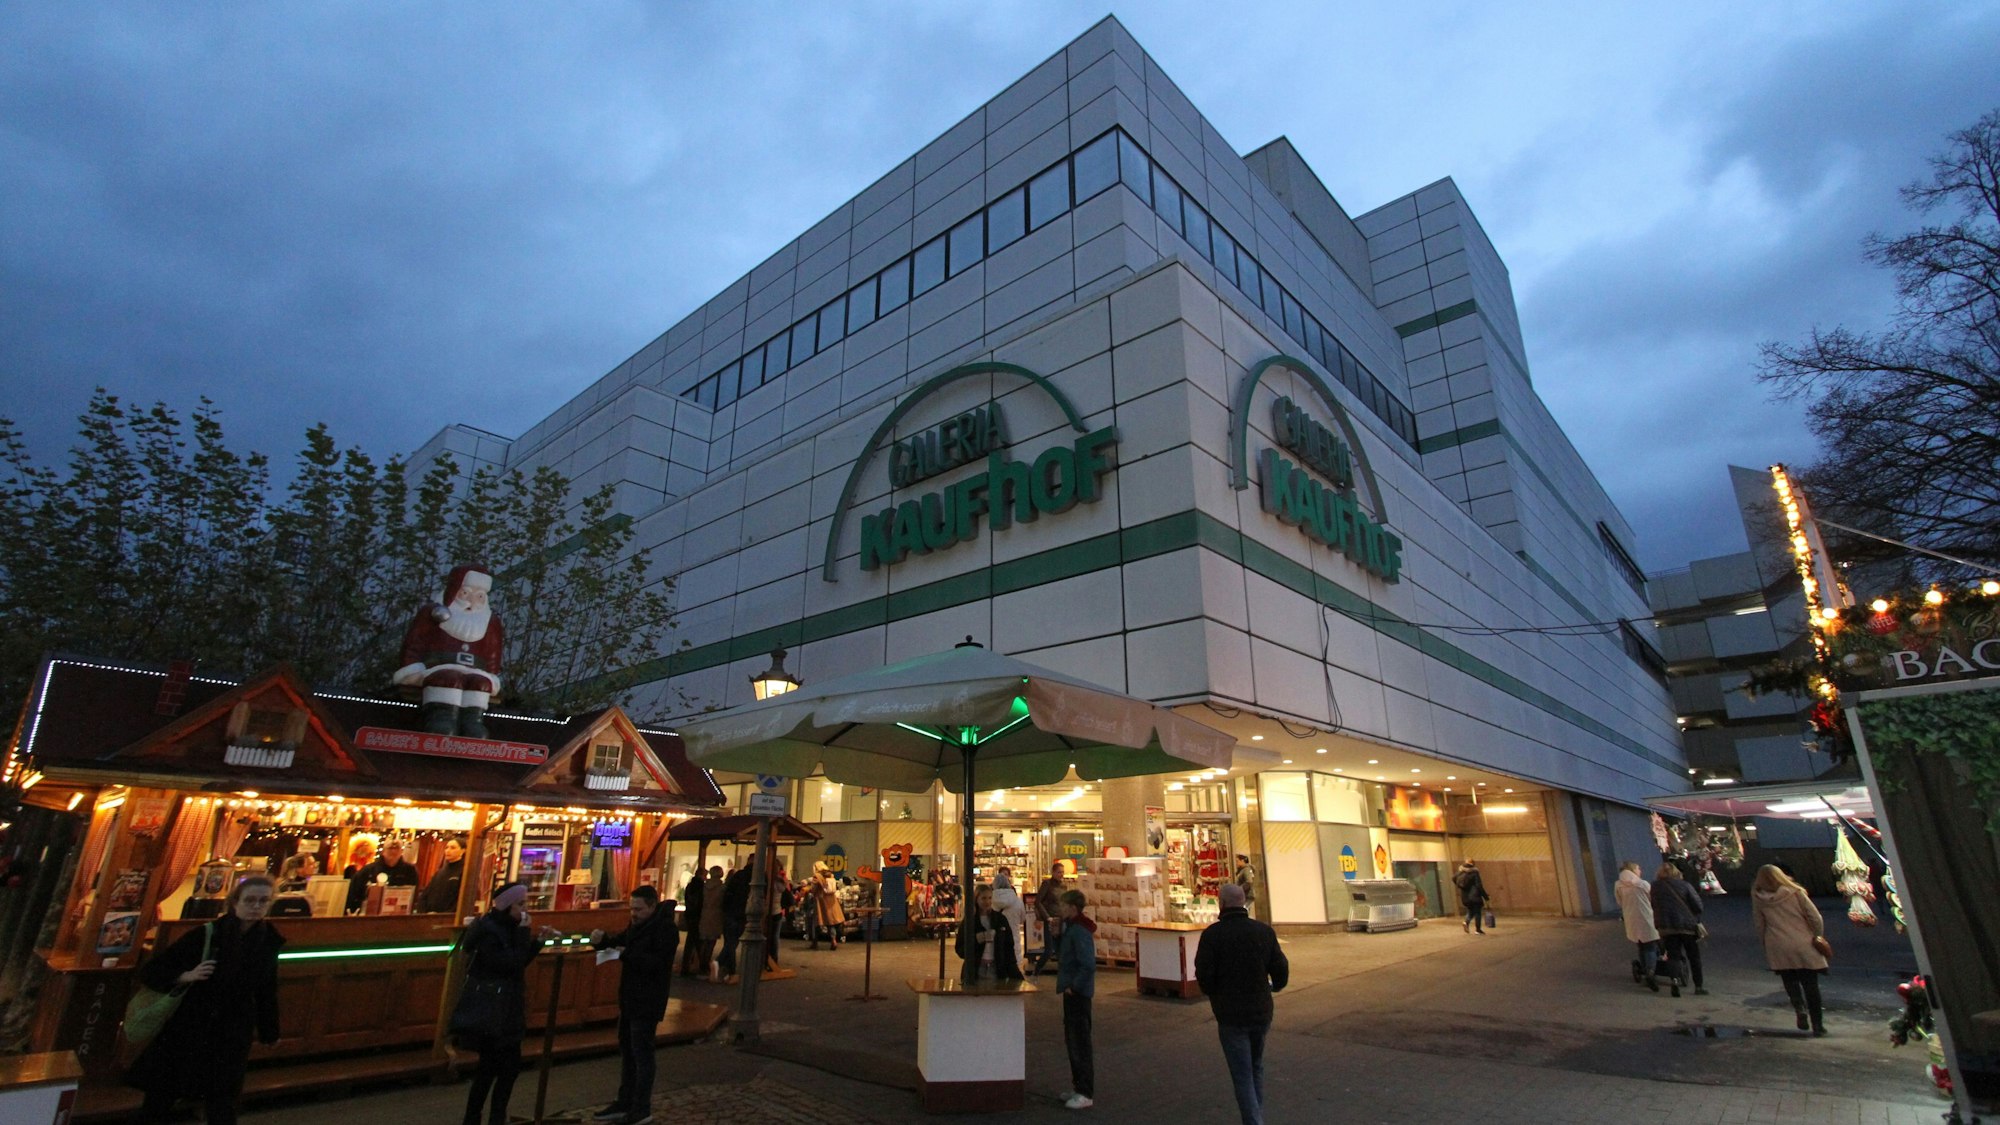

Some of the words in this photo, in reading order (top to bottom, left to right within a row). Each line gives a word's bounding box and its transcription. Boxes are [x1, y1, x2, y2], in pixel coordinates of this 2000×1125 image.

[889, 400, 1010, 488] GALERIA
[1272, 396, 1355, 488] GALERIA
[423, 736, 528, 760] GLÜHWEINHÜTTE
[1063, 844, 1088, 855] TEDi
[1338, 855, 1358, 872] TEDi
